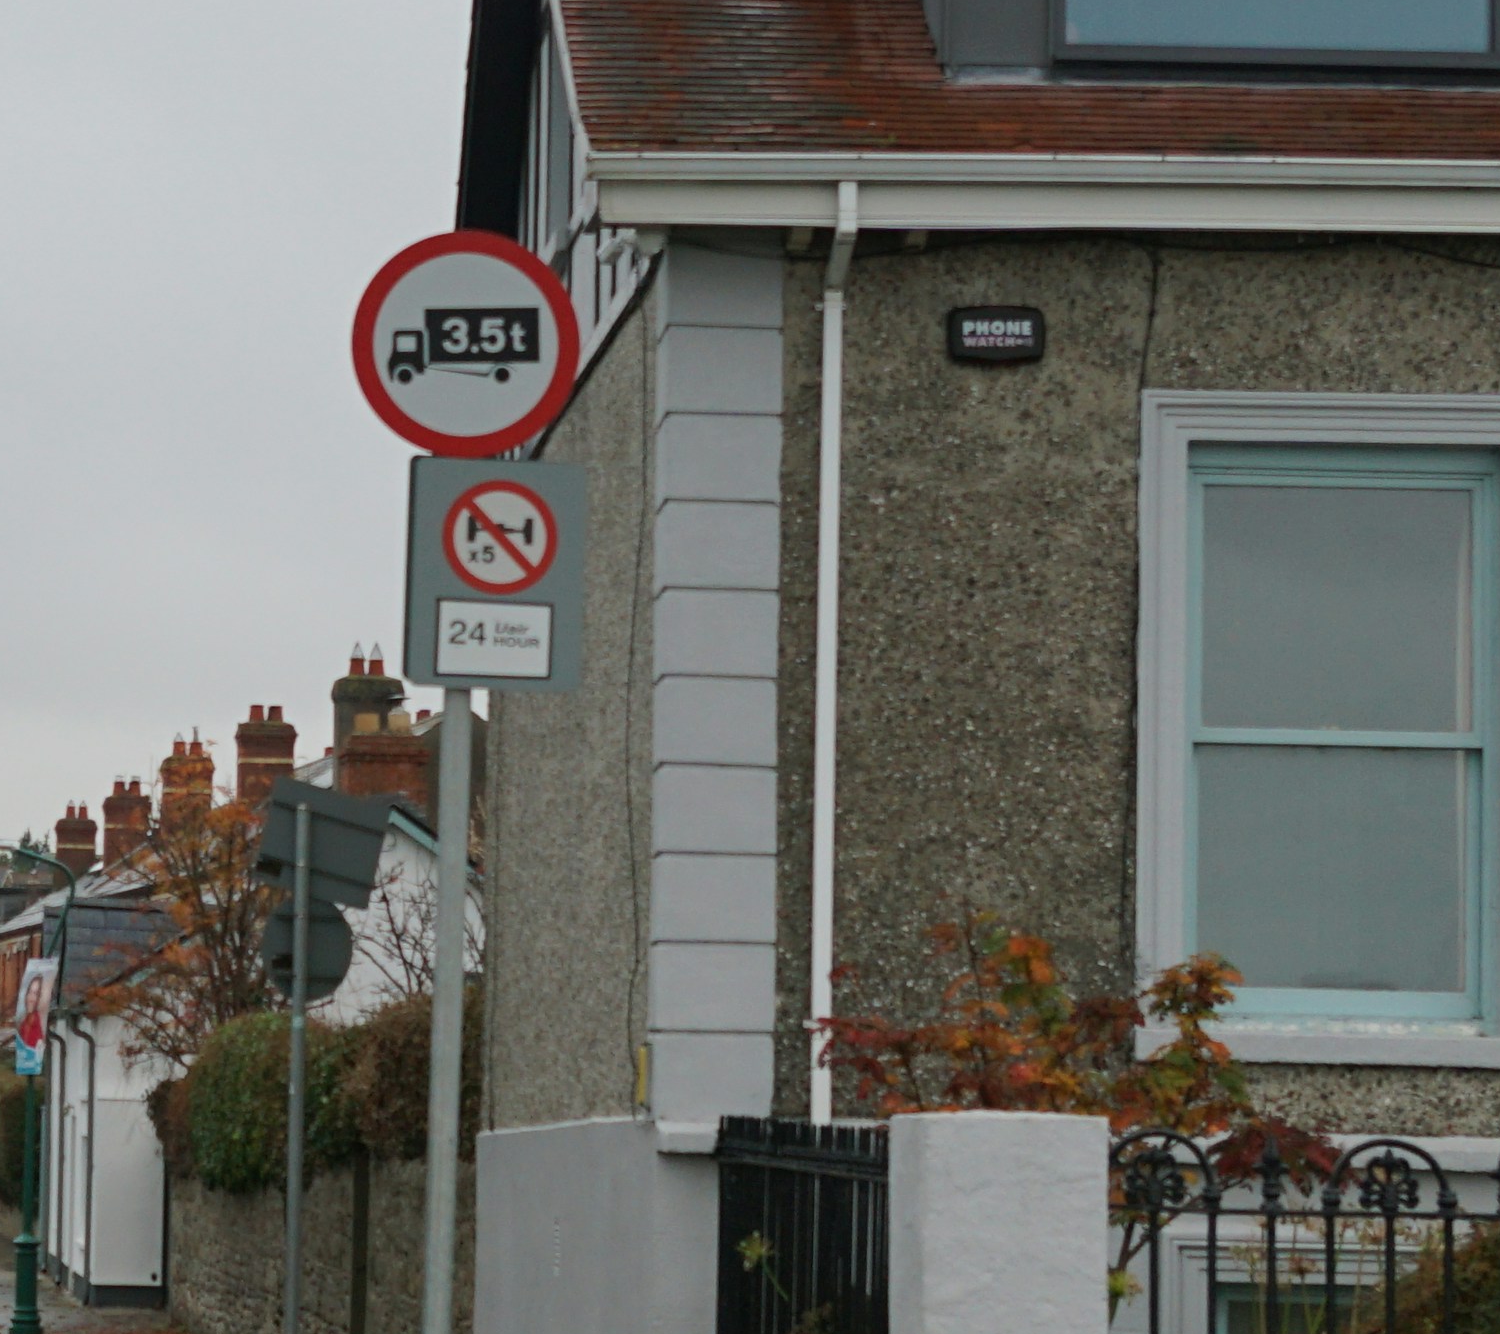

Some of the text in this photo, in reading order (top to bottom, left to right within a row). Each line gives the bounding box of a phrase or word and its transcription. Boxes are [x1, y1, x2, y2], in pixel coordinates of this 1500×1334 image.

[440, 316, 528, 354] 3.5t
[961, 320, 1032, 336] PHONE
[962, 336, 1016, 348] WATCH
[448, 620, 487, 646] 24
[493, 637, 540, 650] HOUR
